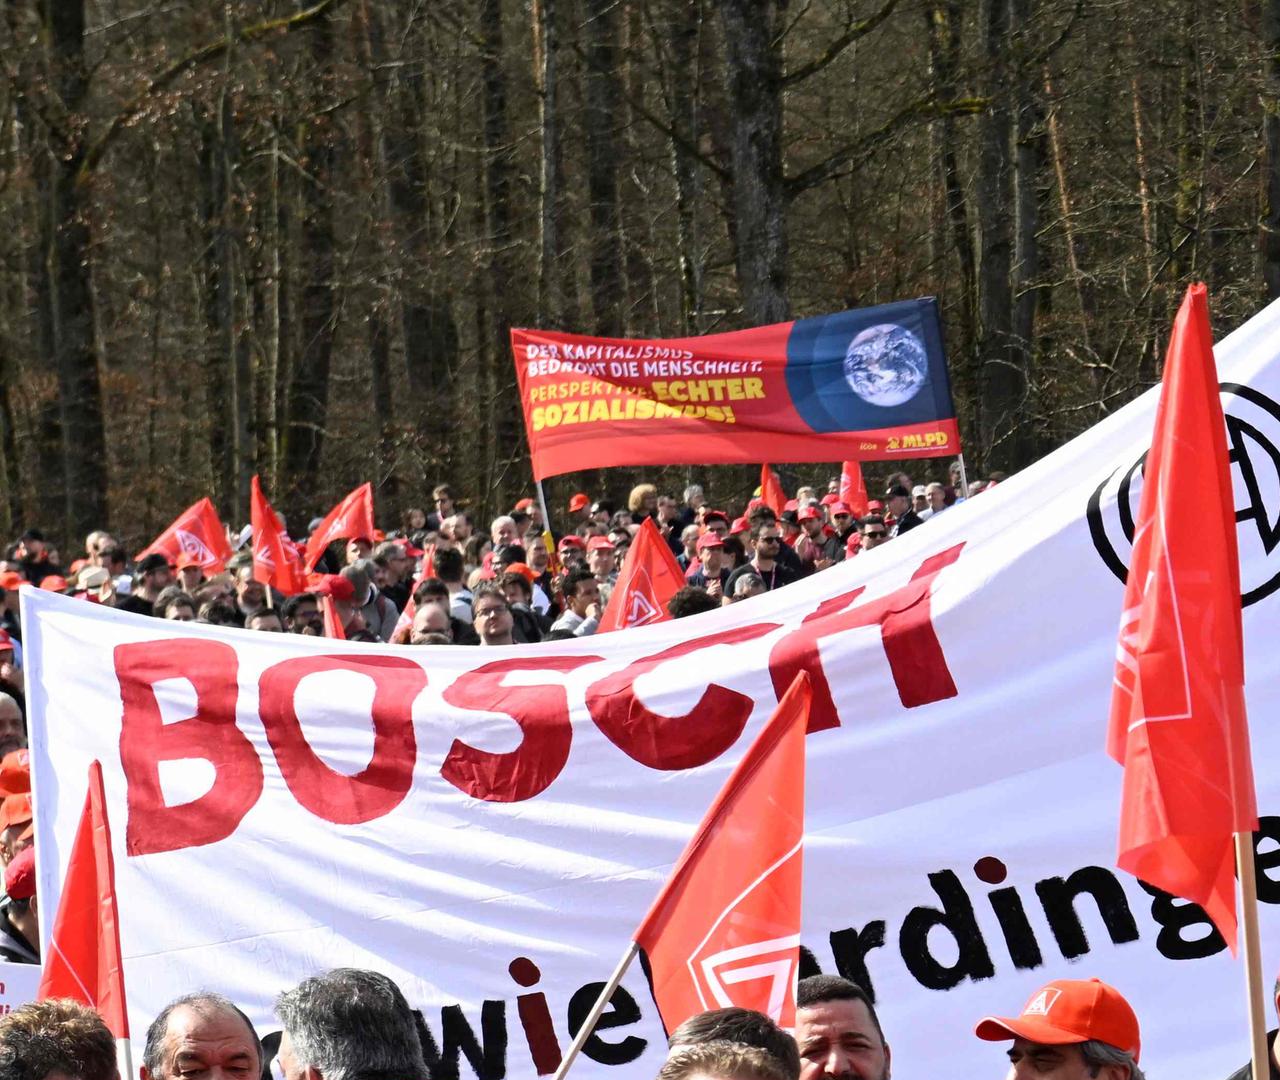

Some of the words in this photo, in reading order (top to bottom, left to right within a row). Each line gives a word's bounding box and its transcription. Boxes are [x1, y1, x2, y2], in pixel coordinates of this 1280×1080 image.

[526, 343, 560, 361] DER
[562, 344, 694, 361] KAPITALISMUS
[528, 359, 607, 378] BEDROHT
[609, 361, 640, 378] DIE
[642, 360, 763, 377] MENSCHHEIT.
[651, 376, 766, 401] ECHTER
[531, 398, 737, 432] SOZIALISMUS!
[903, 431, 949, 449] MLPD
[113, 541, 966, 857] BOSCH
